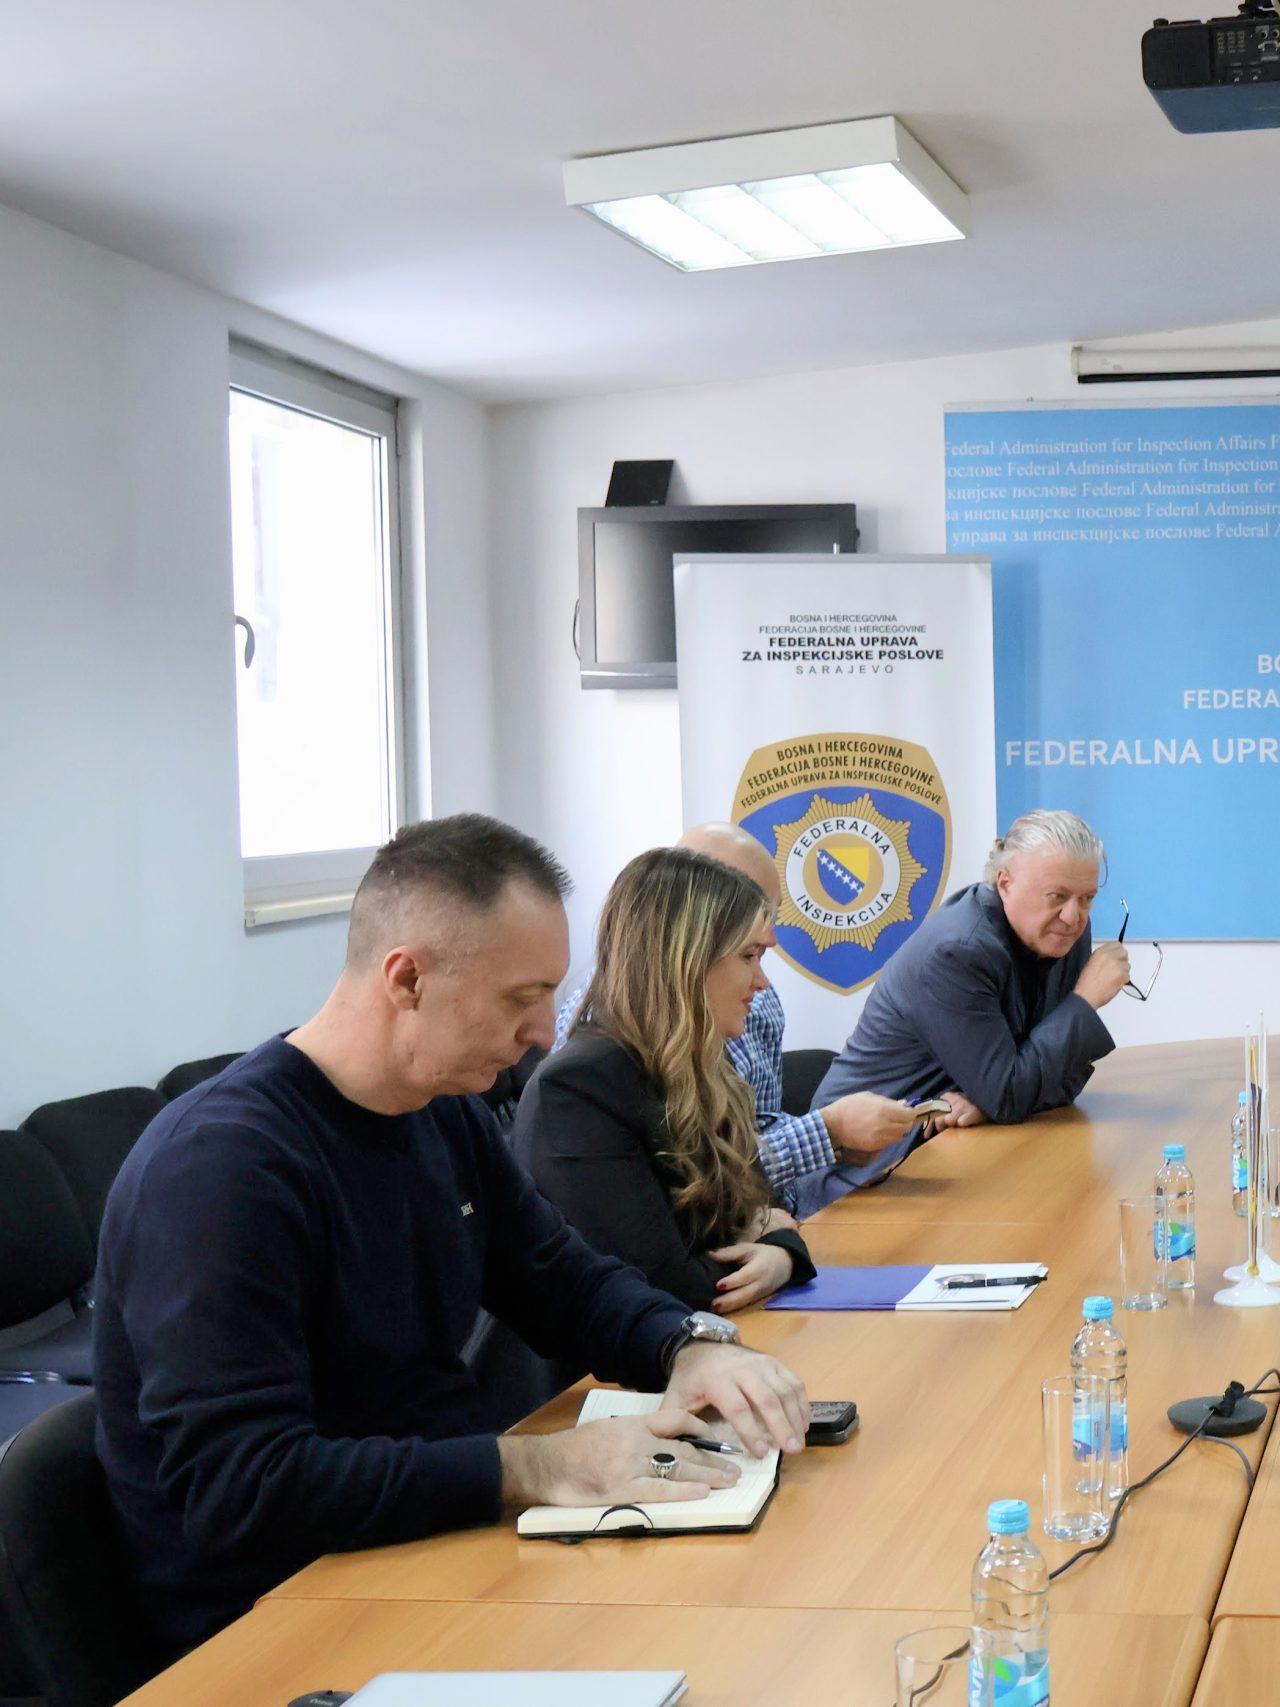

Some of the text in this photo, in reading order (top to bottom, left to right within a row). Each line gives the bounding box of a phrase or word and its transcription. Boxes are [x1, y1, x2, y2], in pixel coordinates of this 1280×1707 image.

[1001, 437, 1106, 454] Administration
[1112, 436, 1132, 451] for
[1138, 434, 1211, 455] Inspection
[1217, 433, 1266, 449] Affairs
[1008, 459, 1060, 476] Federal
[1066, 457, 1173, 474] Administration
[1179, 457, 1198, 472] for
[1204, 455, 1278, 475] Inspection
[1013, 485, 1076, 497] послове
[1083, 480, 1135, 496] Federal
[1141, 478, 1248, 495] Administration
[1254, 477, 1274, 492] for
[965, 503, 1071, 524] инспекцијске
[1077, 506, 1141, 518] послове
[1147, 501, 1199, 517] Federal
[954, 532, 1007, 548] управа
[1013, 531, 1028, 542] за
[1033, 525, 1140, 546] инспекцијске
[1145, 527, 1210, 540] послове
[1216, 522, 1268, 538] Federal
[789, 614, 898, 623] BOSNA I HERCEGOVINA
[759, 625, 926, 634] FEDERACIJA BOSNE I HERCEGOVINE
[769, 636, 918, 647] FEDERALNA UPRAVA
[742, 649, 944, 662] ZA INSPEKCIJSKE POSLOVE
[795, 664, 894, 675] SARAJEVO
[777, 741, 903, 761] BOSNA I HERCEGOVINA
[1007, 739, 1201, 765] FEDERALNA
[747, 756, 935, 789] FEDERACIJA BOSNE I HERCEGOVINE
[741, 770, 942, 808] FEDERALNA UPRAVA ZA INSPEKCIJSKE POSLOVE
[793, 819, 891, 857] FEDERALNA
[797, 892, 892, 927] INSPEKCIJA
